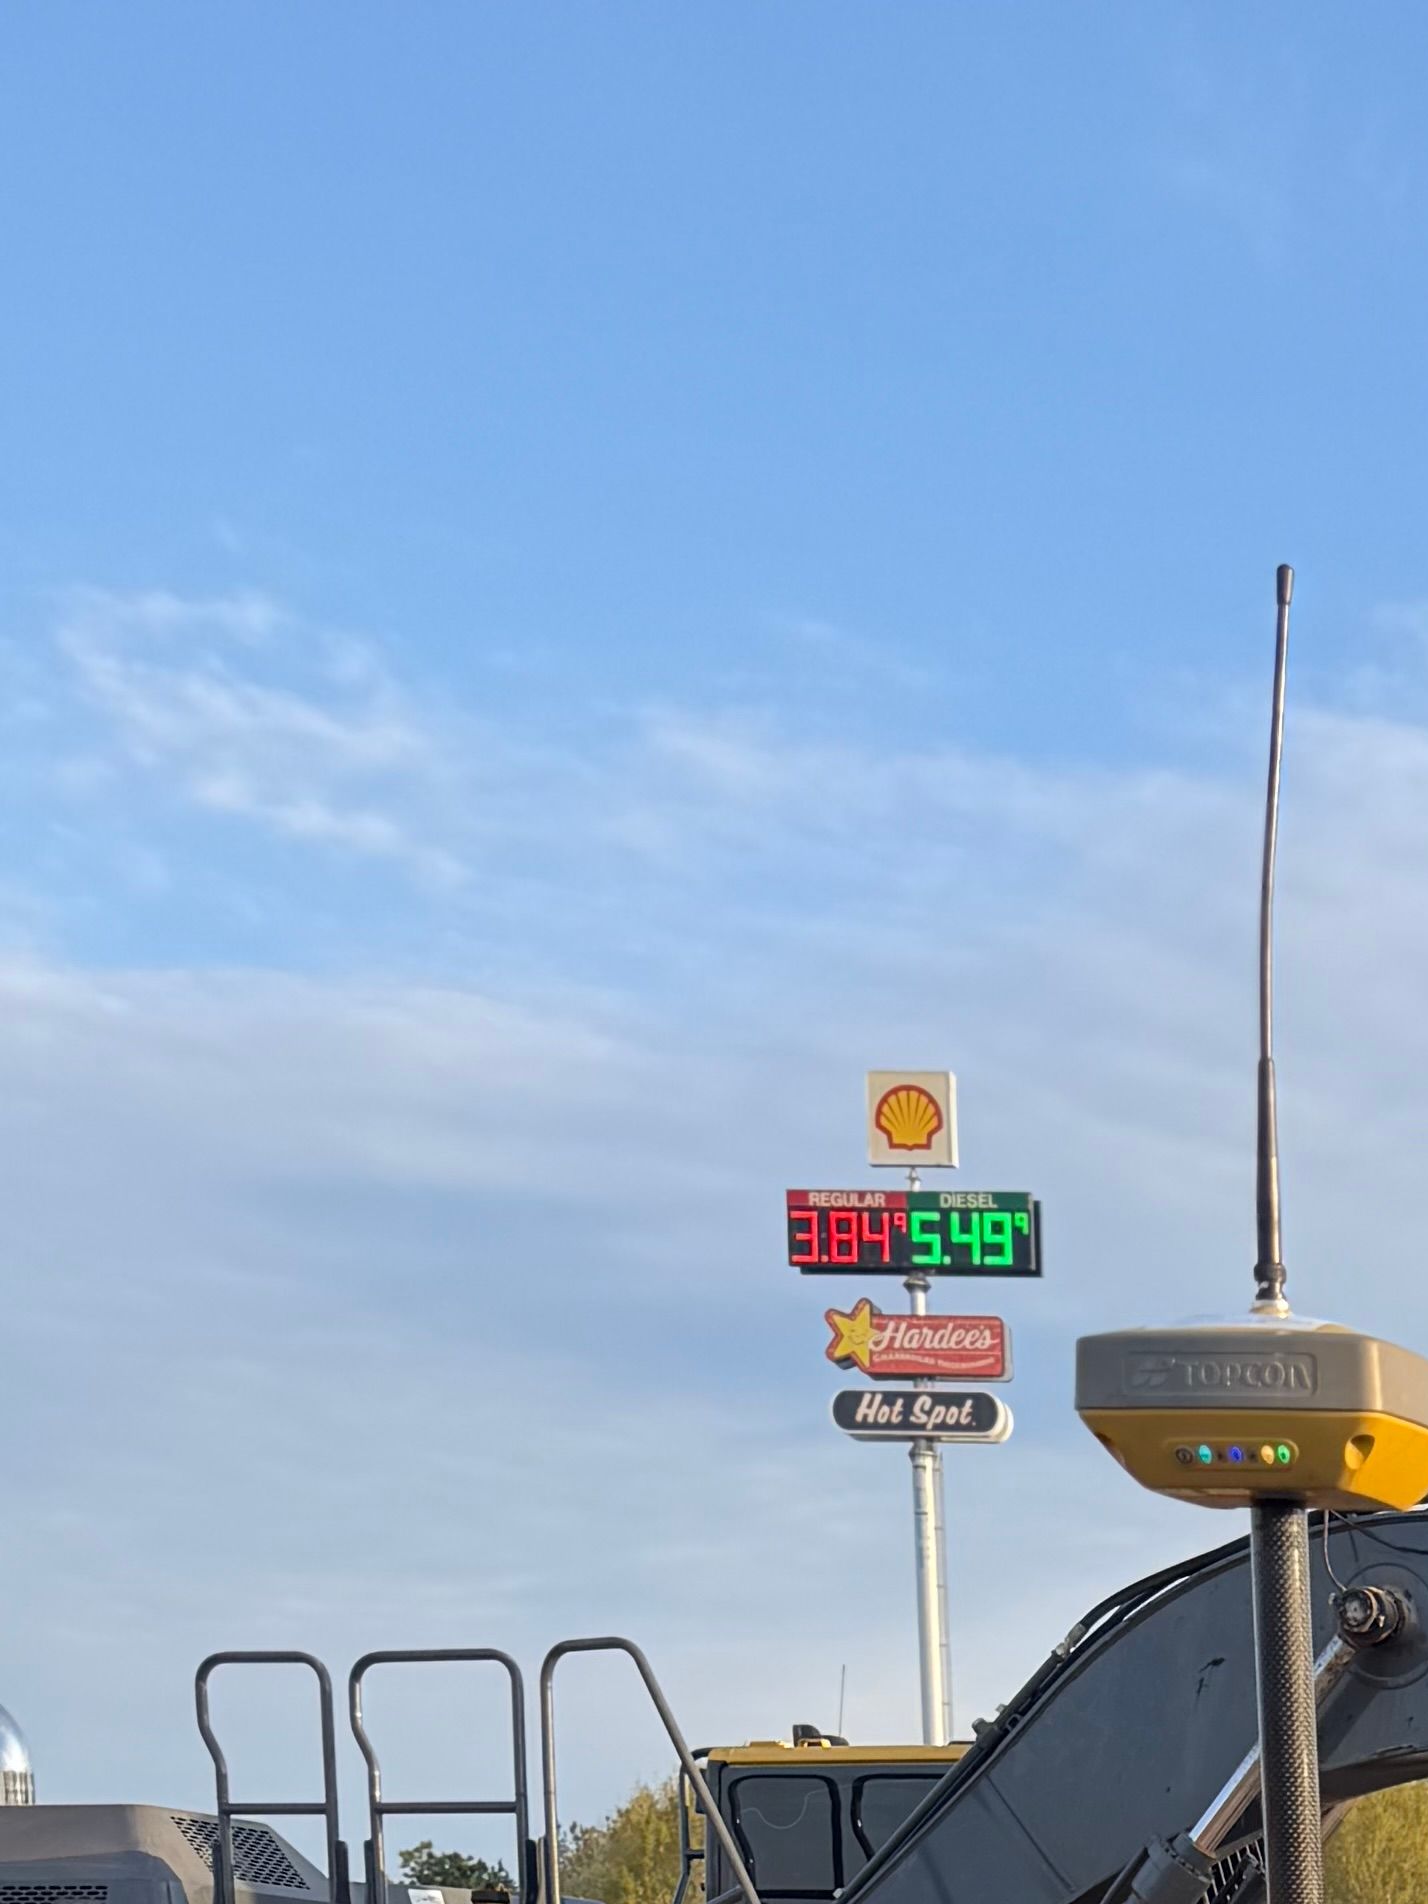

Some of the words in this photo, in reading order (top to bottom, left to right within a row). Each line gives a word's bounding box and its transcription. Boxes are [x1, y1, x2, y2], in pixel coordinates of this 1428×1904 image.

[808, 1192, 886, 1207] REGULAR
[939, 1193, 998, 1209] DIESEL
[869, 1321, 1000, 1351] Hardee's
[1182, 1360, 1312, 1389] TOPCON
[855, 1392, 904, 1424] Hot
